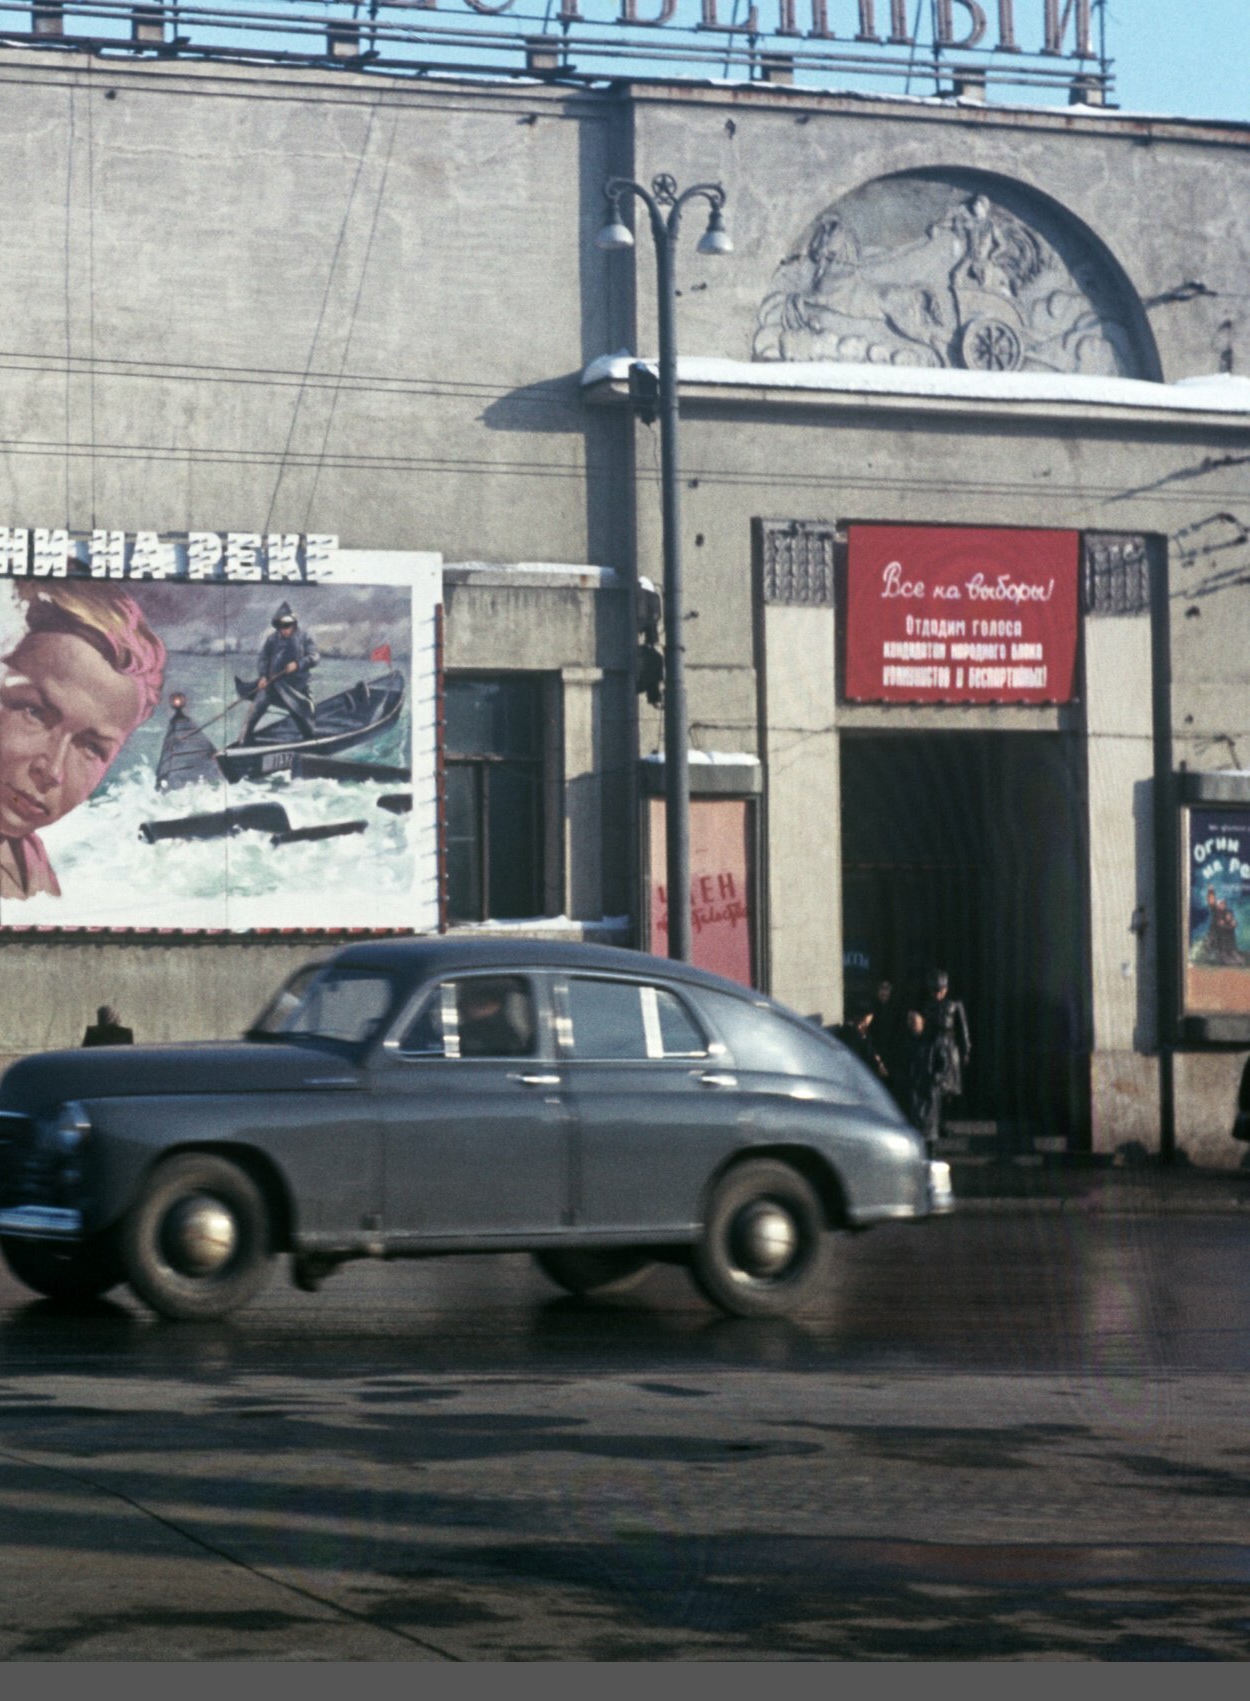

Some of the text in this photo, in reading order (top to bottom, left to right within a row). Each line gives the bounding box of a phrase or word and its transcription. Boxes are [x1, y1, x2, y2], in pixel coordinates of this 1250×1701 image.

[91, 529, 166, 579] НА
[187, 531, 339, 582] РЕКЕ
[881, 561, 1055, 604] Все на выборы!
